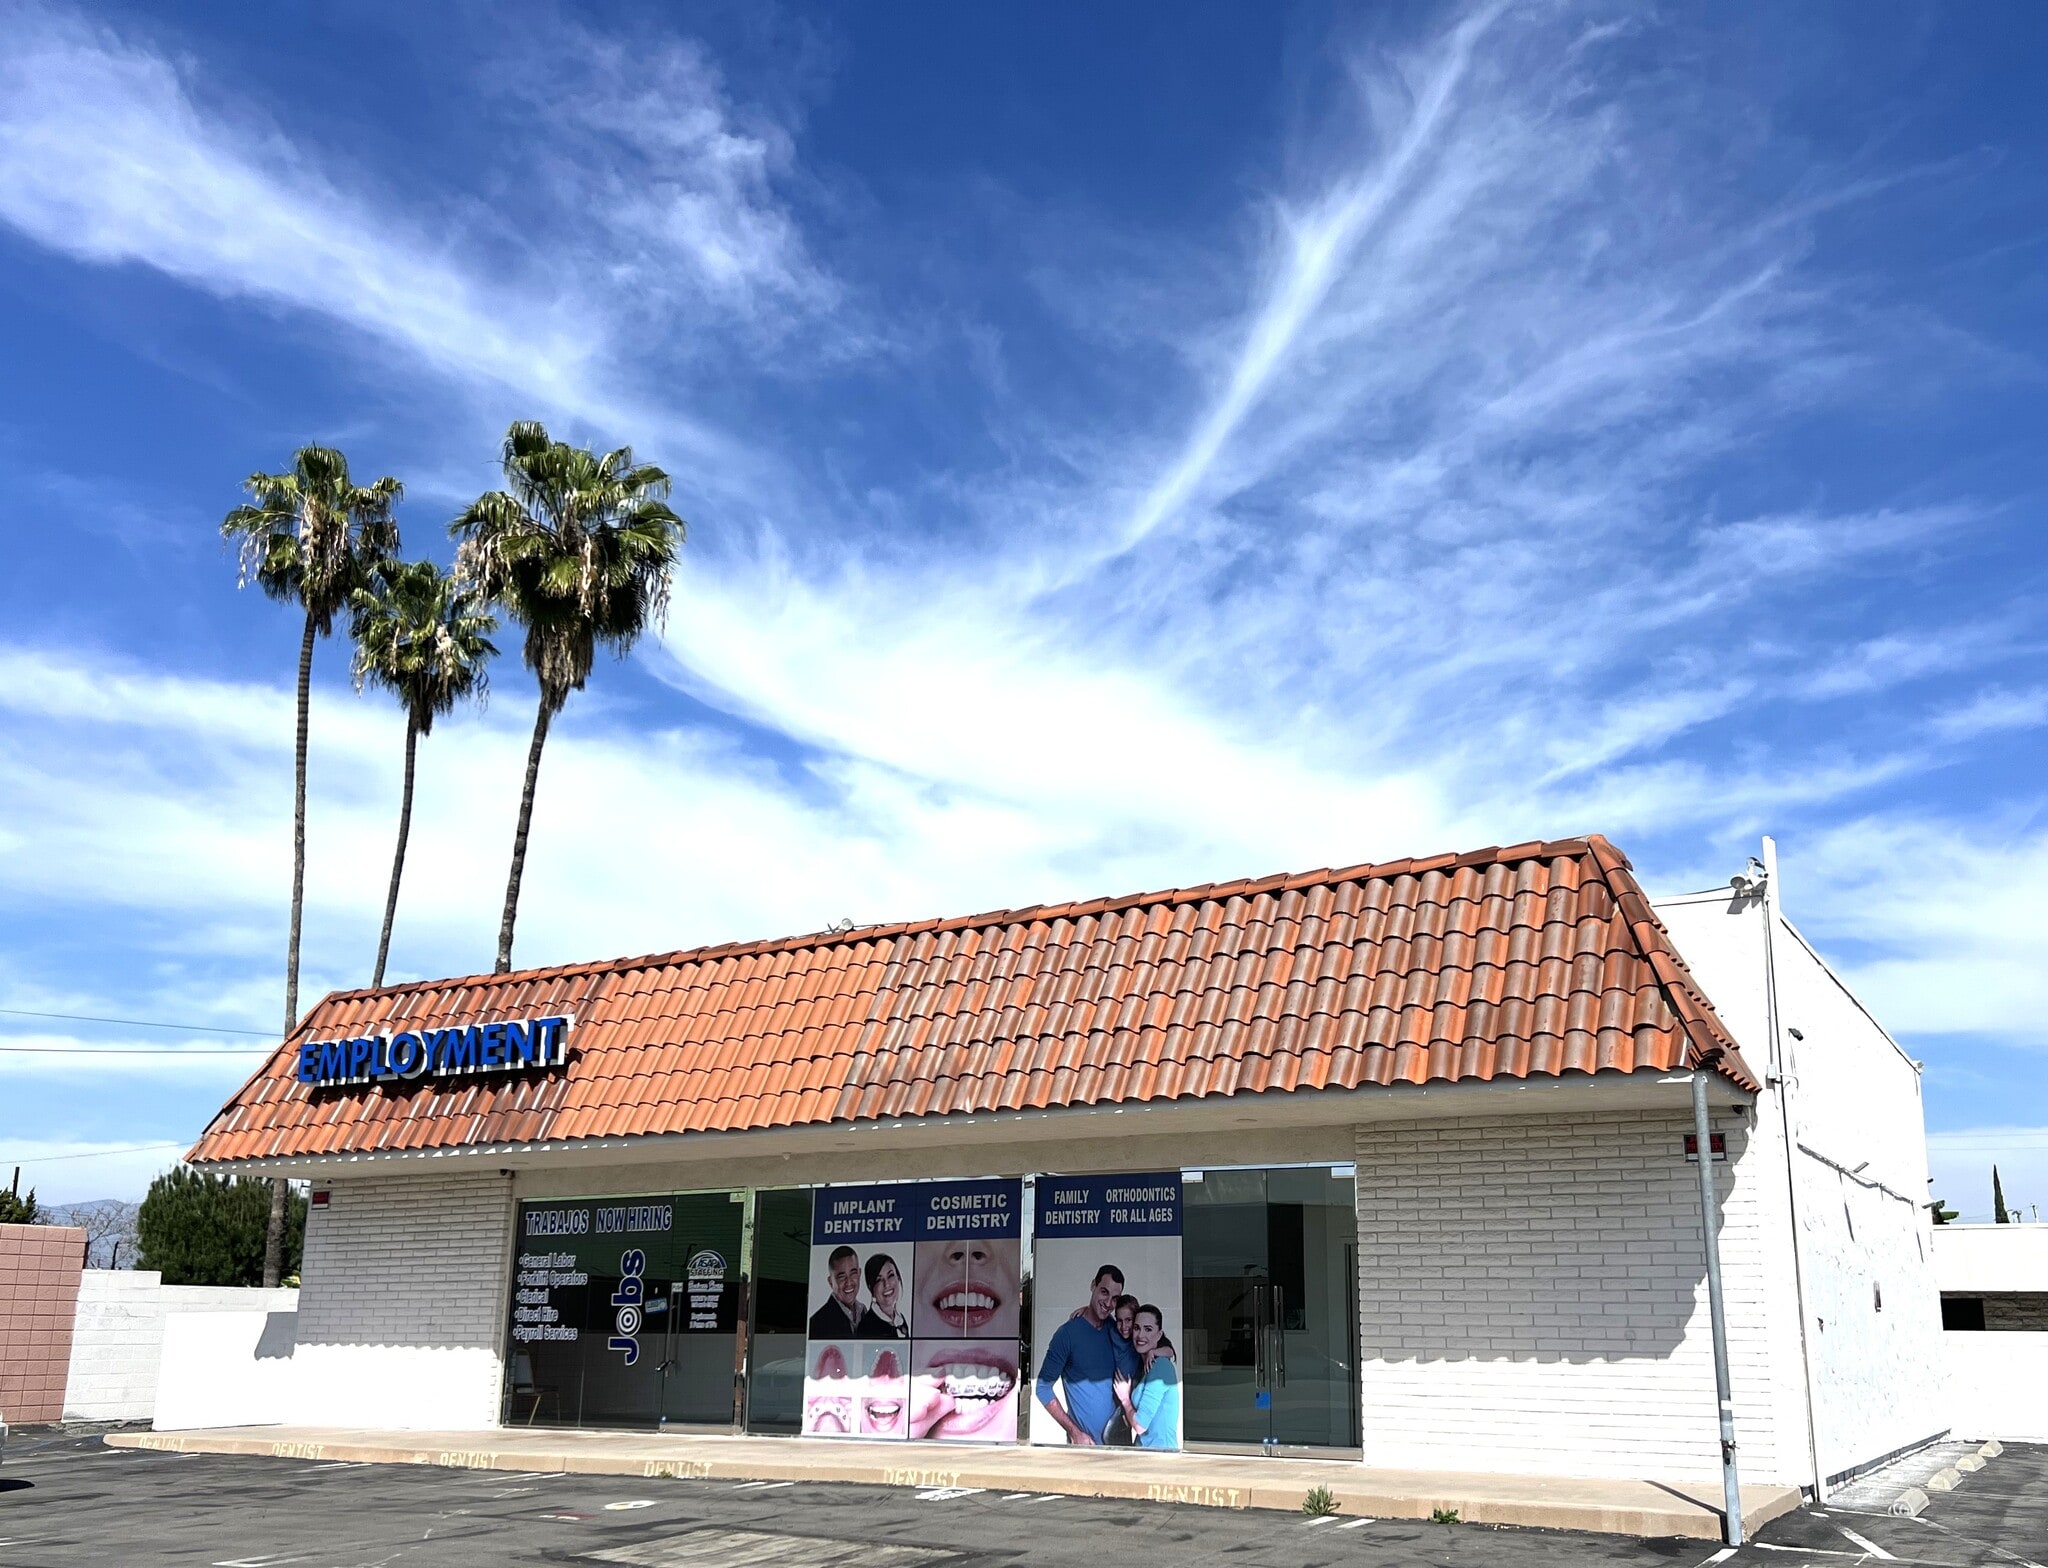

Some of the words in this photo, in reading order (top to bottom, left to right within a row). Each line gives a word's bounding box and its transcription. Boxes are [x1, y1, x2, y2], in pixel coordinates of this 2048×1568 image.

[298, 1016, 567, 1083] EMPLOYMENT
[930, 1194, 1007, 1211] COSMETIC
[1054, 1190, 1089, 1204] FAMILY
[1105, 1187, 1176, 1203] ORTHODONTICS
[833, 1199, 896, 1215] IMPLANT
[1110, 1208, 1128, 1223] FOR
[1129, 1208, 1147, 1223] ALL
[1148, 1207, 1173, 1222] AGES
[526, 1209, 589, 1235] TRABAJOS
[595, 1207, 626, 1233] NOW
[627, 1205, 673, 1232] HIRING
[824, 1217, 904, 1234] DENTISTRY
[926, 1213, 1011, 1230] DENTISTRY
[1045, 1209, 1101, 1225] DENTISTRY
[521, 1252, 552, 1268] General
[552, 1252, 577, 1268] Labor
[520, 1270, 549, 1286] Forklift
[549, 1269, 588, 1289] Operators
[519, 1288, 549, 1304] Clerical
[517, 1306, 541, 1322] Direct
[541, 1306, 559, 1322] Hire
[515, 1324, 544, 1343] Payroll
[543, 1324, 578, 1341] Services
[272, 1442, 325, 1460] DENTIST
[439, 1452, 499, 1470] DENTIST
[1147, 1484, 1240, 1507] DENTIST
